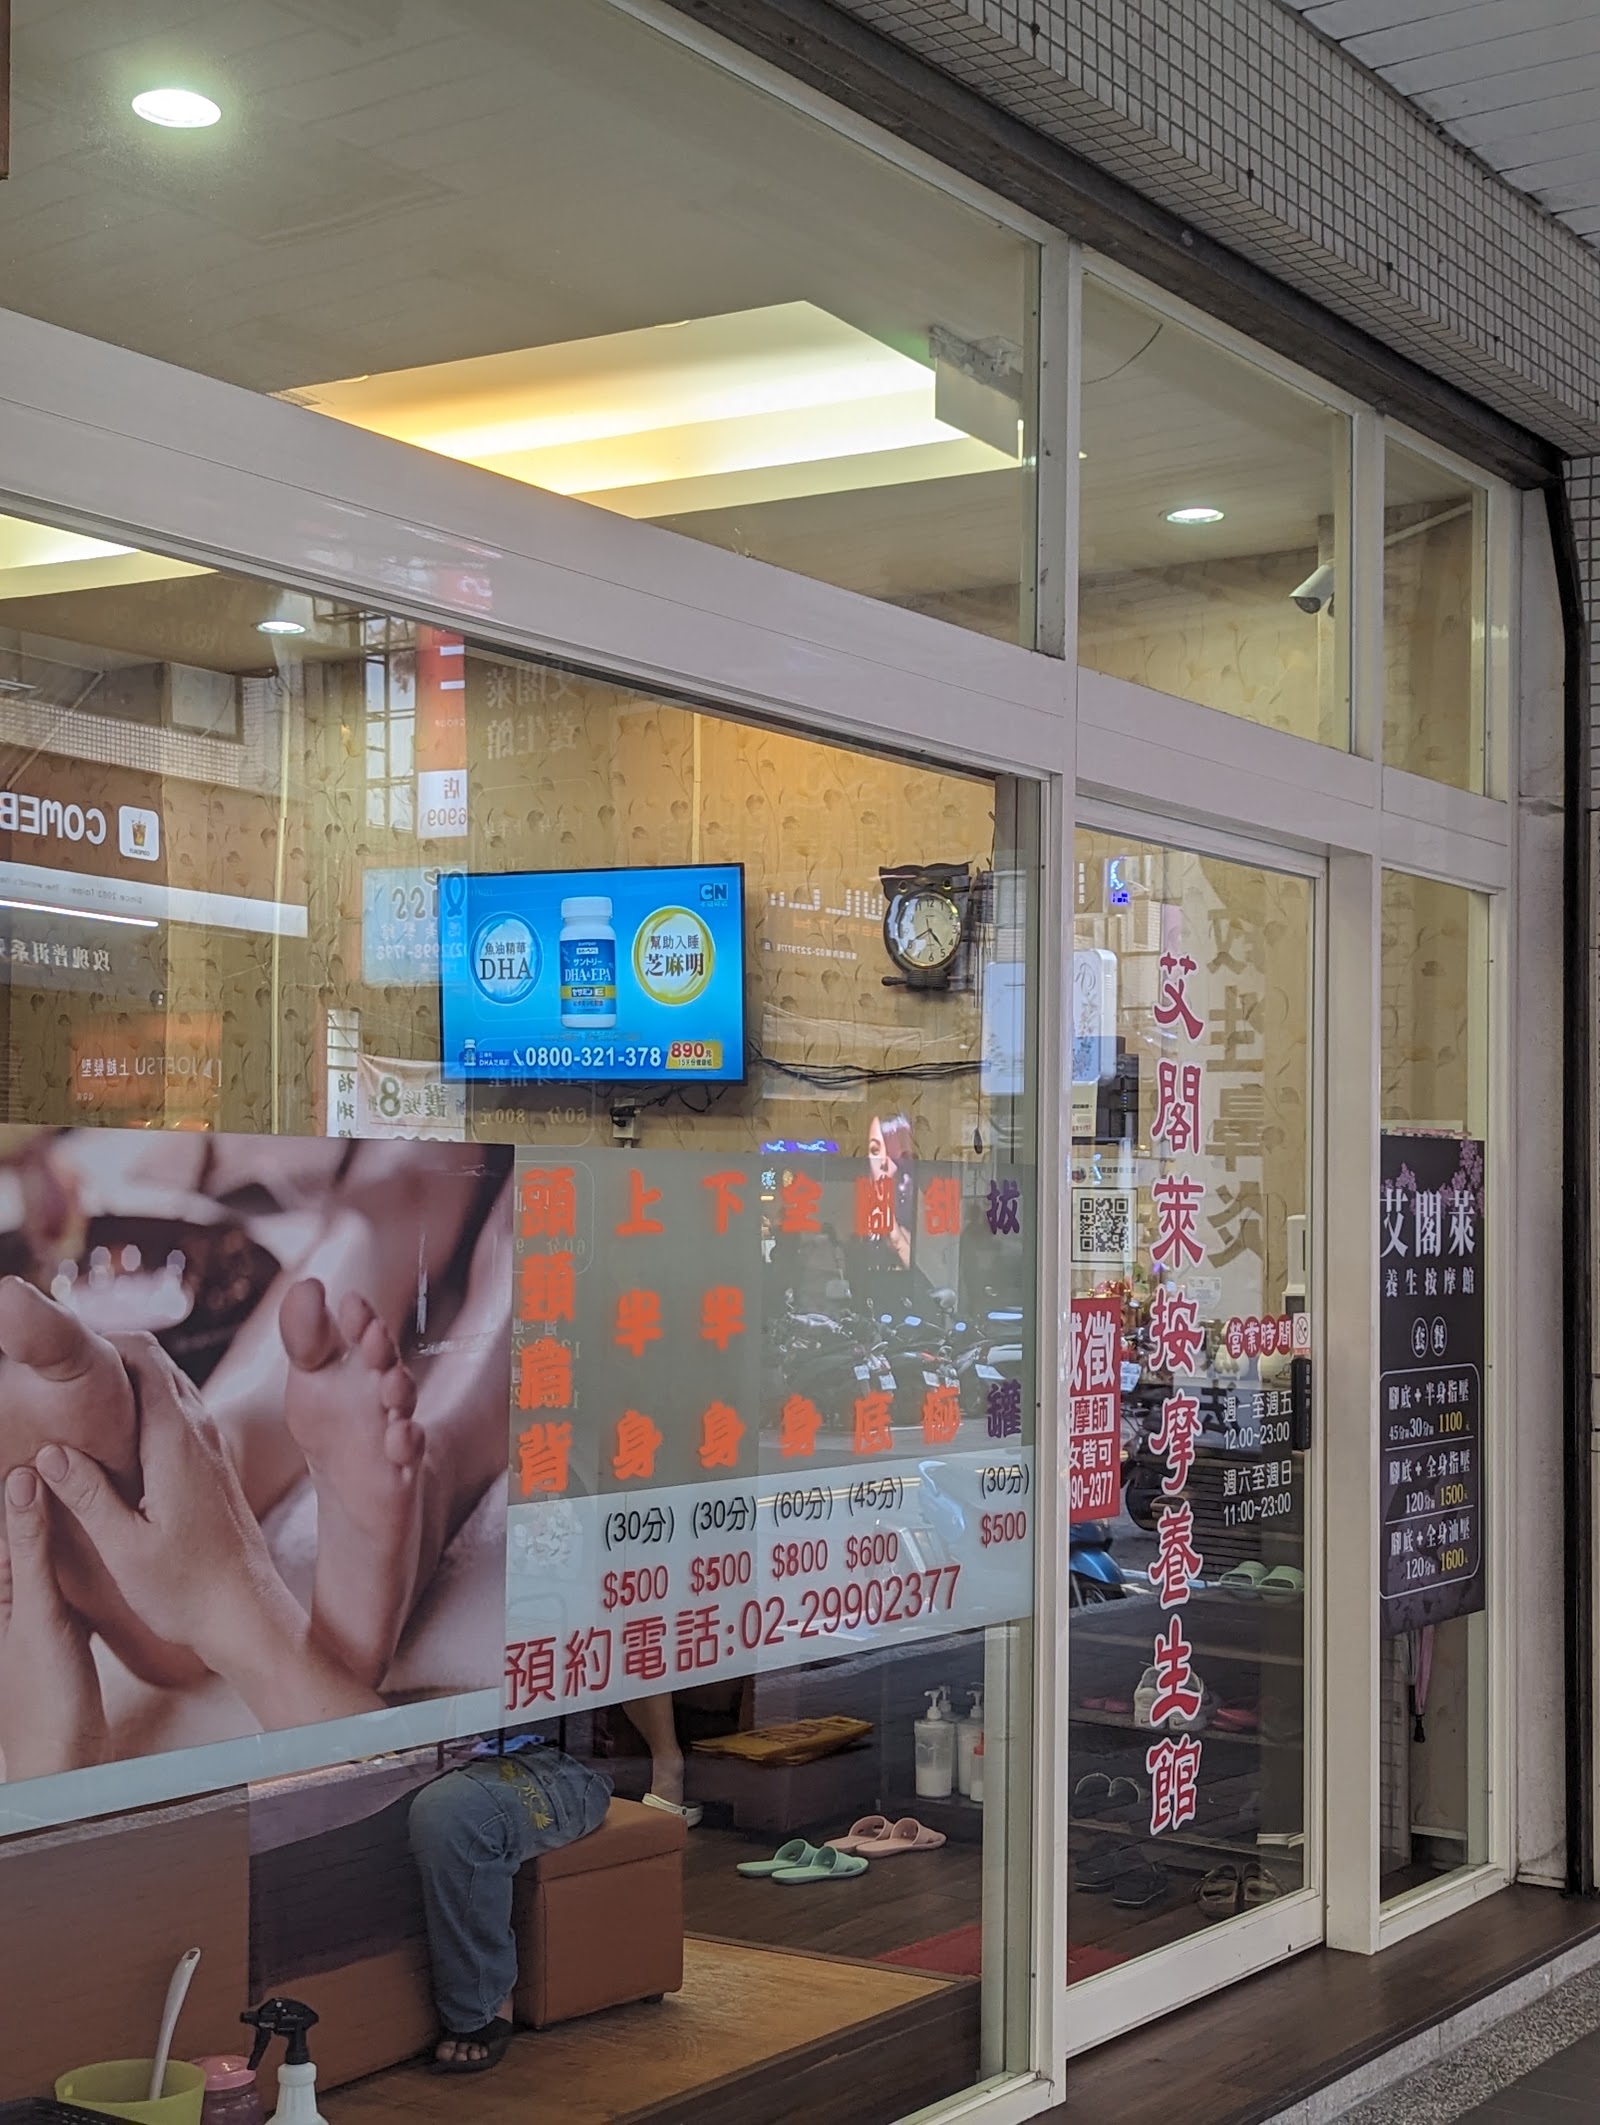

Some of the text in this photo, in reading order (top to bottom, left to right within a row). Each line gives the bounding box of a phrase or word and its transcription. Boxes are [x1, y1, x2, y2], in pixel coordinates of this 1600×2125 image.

[699, 882, 729, 902] CN
[484, 941, 526, 956] 魚油精華
[650, 934, 700, 950] 幫助入睡
[479, 957, 534, 980] DHA
[644, 952, 705, 977] 芝麻明
[525, 1046, 662, 1068] 0800-321-378
[671, 1041, 713, 1059] 890元
[1380, 1187, 1476, 1259] 艾閣萊
[1385, 1266, 1475, 1298] 養生按摩館
[613, 1169, 666, 1482] 上半身
[698, 1170, 750, 1469] 下半身
[778, 1164, 825, 1460] 全身
[986, 1178, 1025, 1441] 拔罐
[1227, 1318, 1293, 1357] 營業時間
[1414, 1324, 1445, 1351] 套餐
[1148, 952, 1205, 1836] 艾閣萊按摩養生館
[1222, 1391, 1294, 1424] 週一至週五
[1070, 1398, 1109, 1435] 摩師
[1222, 1459, 1292, 1498] 週六至週日
[604, 1462, 1031, 1551] (30分) (30分) (60分) (45分) (30分)
[603, 1512, 1028, 1613] $500 $500 $800 $600 $500
